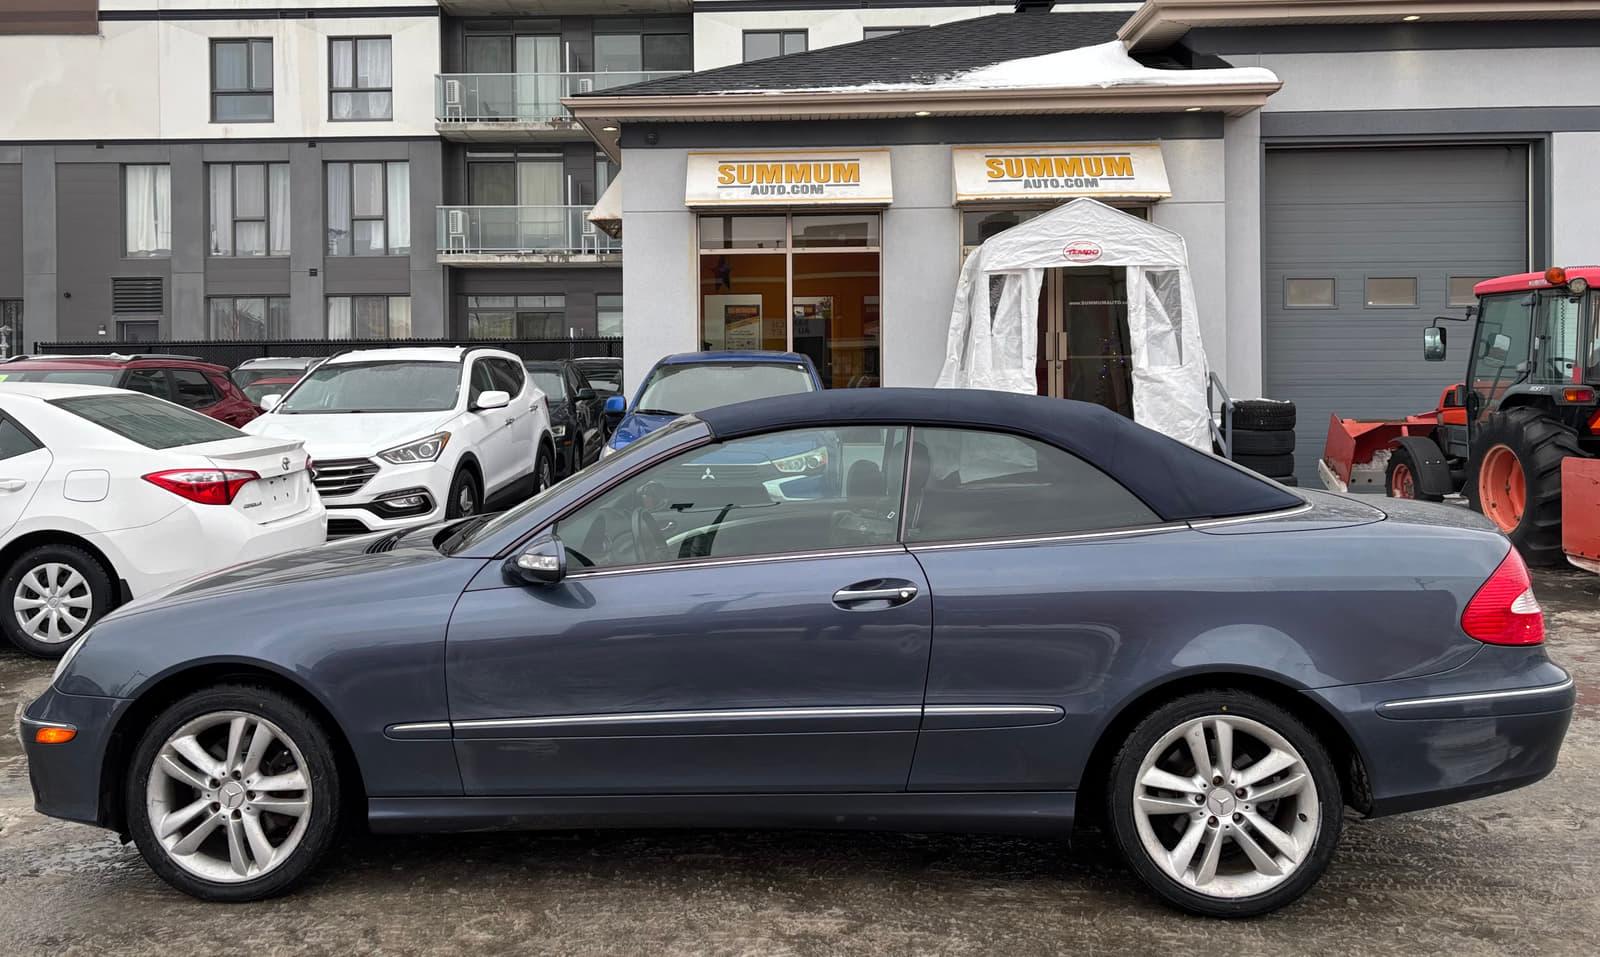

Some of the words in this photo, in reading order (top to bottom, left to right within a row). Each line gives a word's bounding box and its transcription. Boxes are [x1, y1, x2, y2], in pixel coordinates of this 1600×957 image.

[717, 162, 860, 185] SUMMUM
[984, 156, 1135, 179] SUMMUM
[750, 184, 824, 196] AUTO.COM
[1023, 178, 1099, 189] AUTO.COM
